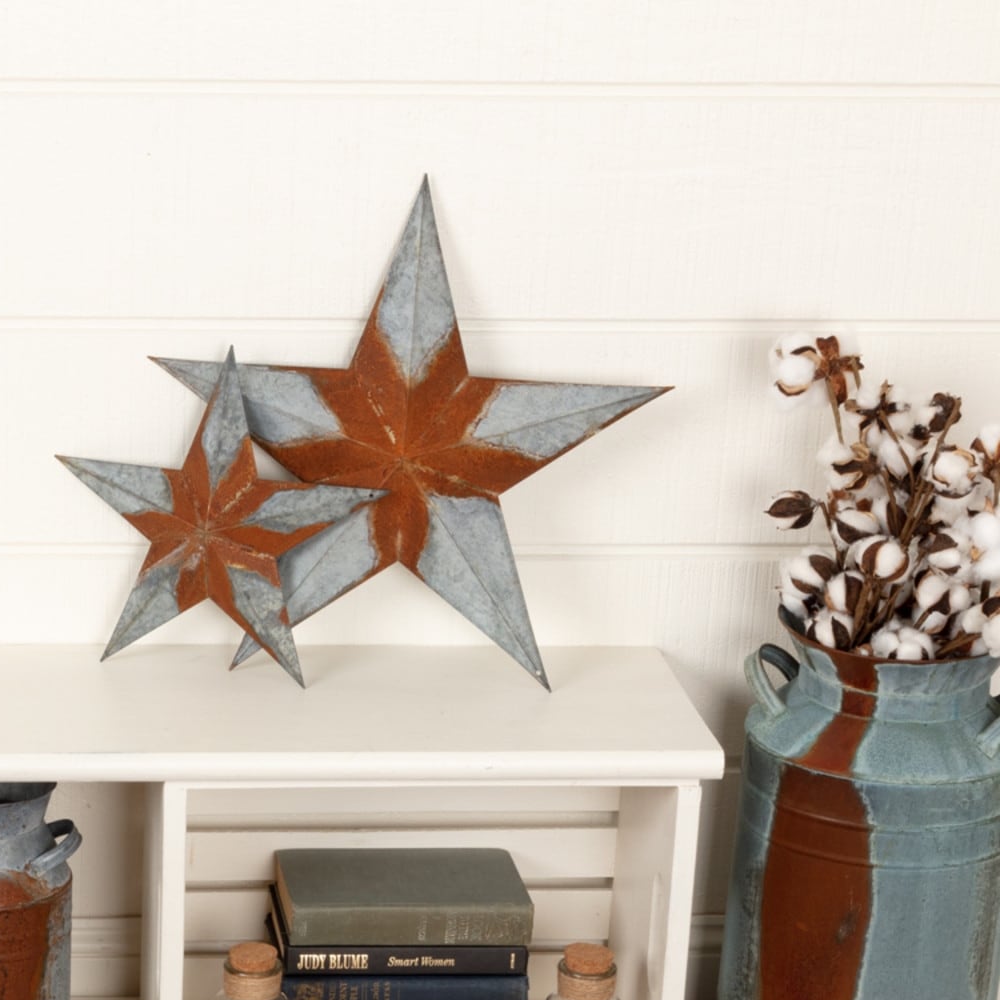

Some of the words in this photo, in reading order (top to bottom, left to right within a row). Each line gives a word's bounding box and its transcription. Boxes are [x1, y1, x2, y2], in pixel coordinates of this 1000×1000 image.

[297, 953, 326, 970] JUDY
[329, 953, 369, 970] BLUME
[387, 956, 419, 967] Smart
[421, 956, 456, 967] Women
